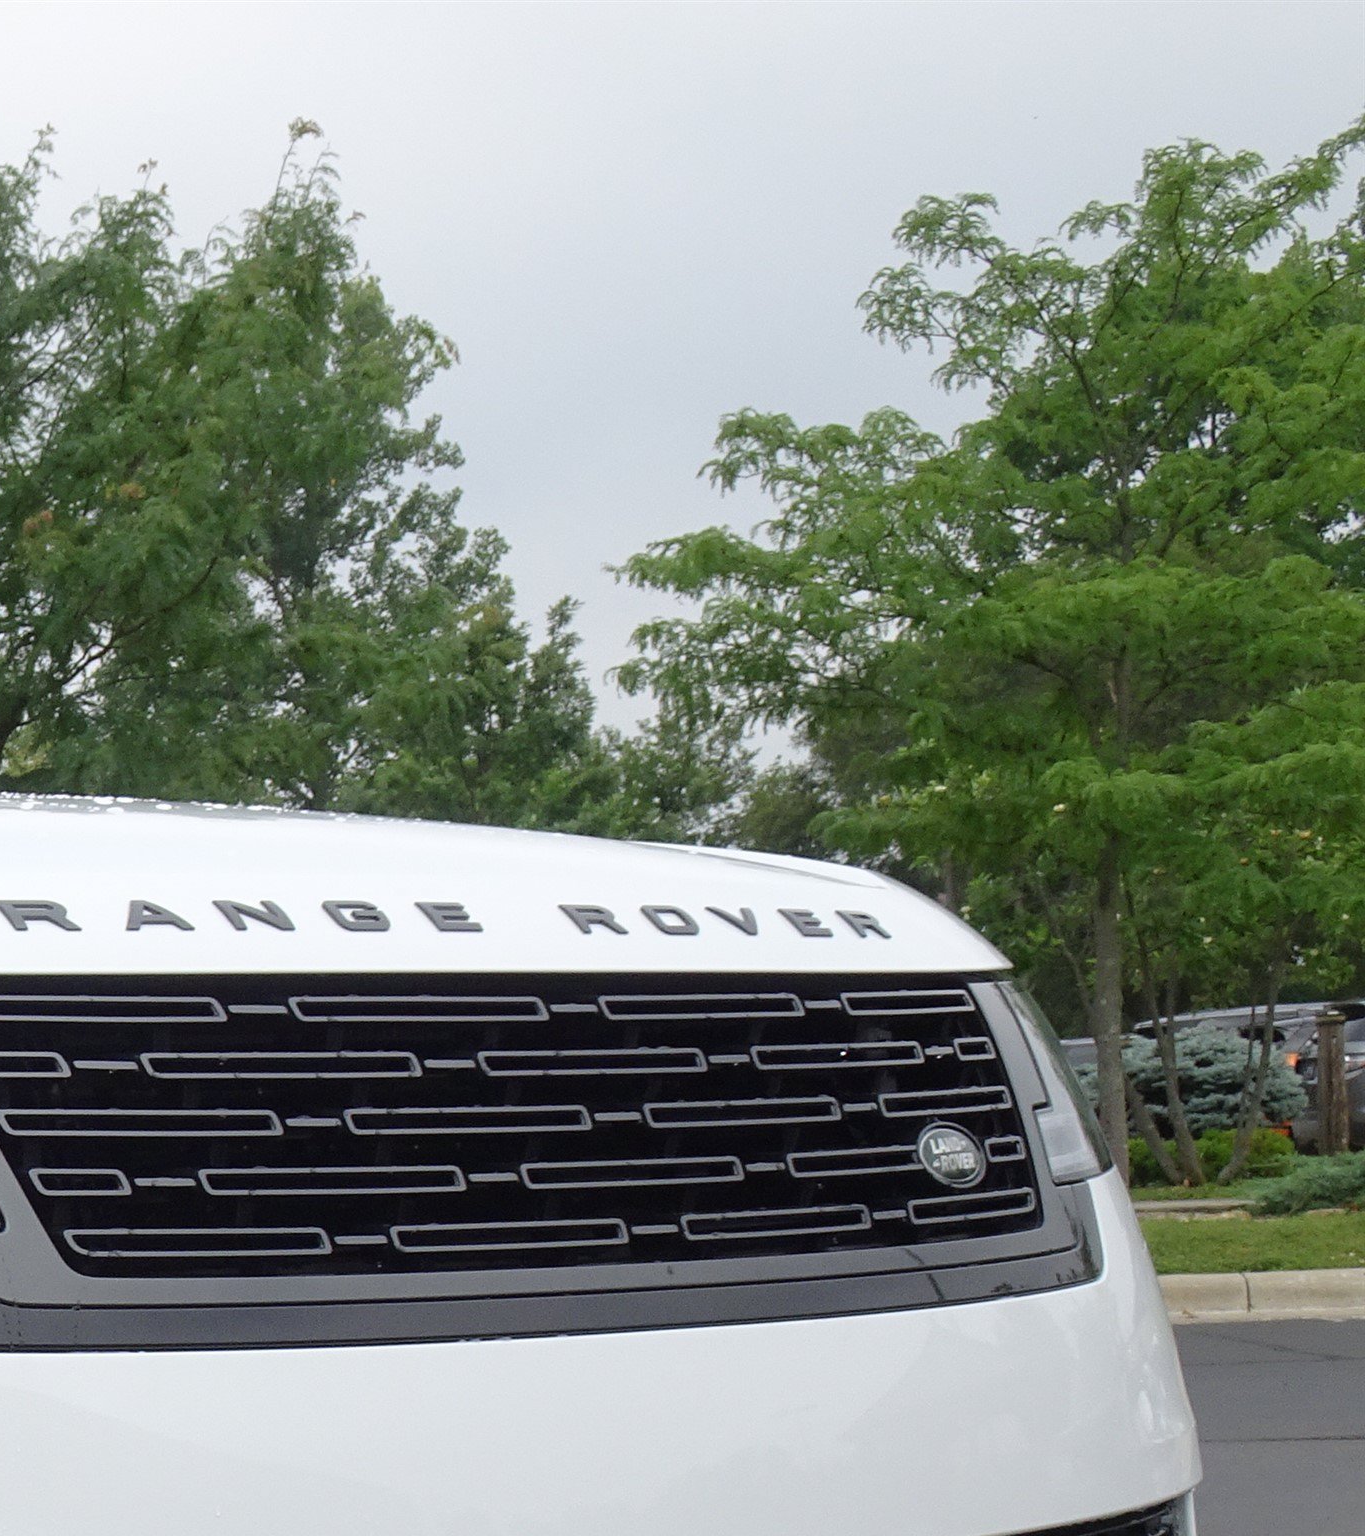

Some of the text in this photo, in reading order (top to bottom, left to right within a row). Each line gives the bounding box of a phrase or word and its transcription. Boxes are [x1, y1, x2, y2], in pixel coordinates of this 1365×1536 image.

[557, 903, 893, 939] ROVER
[929, 1137, 961, 1154] LAND
[941, 1152, 975, 1171] ROVER
